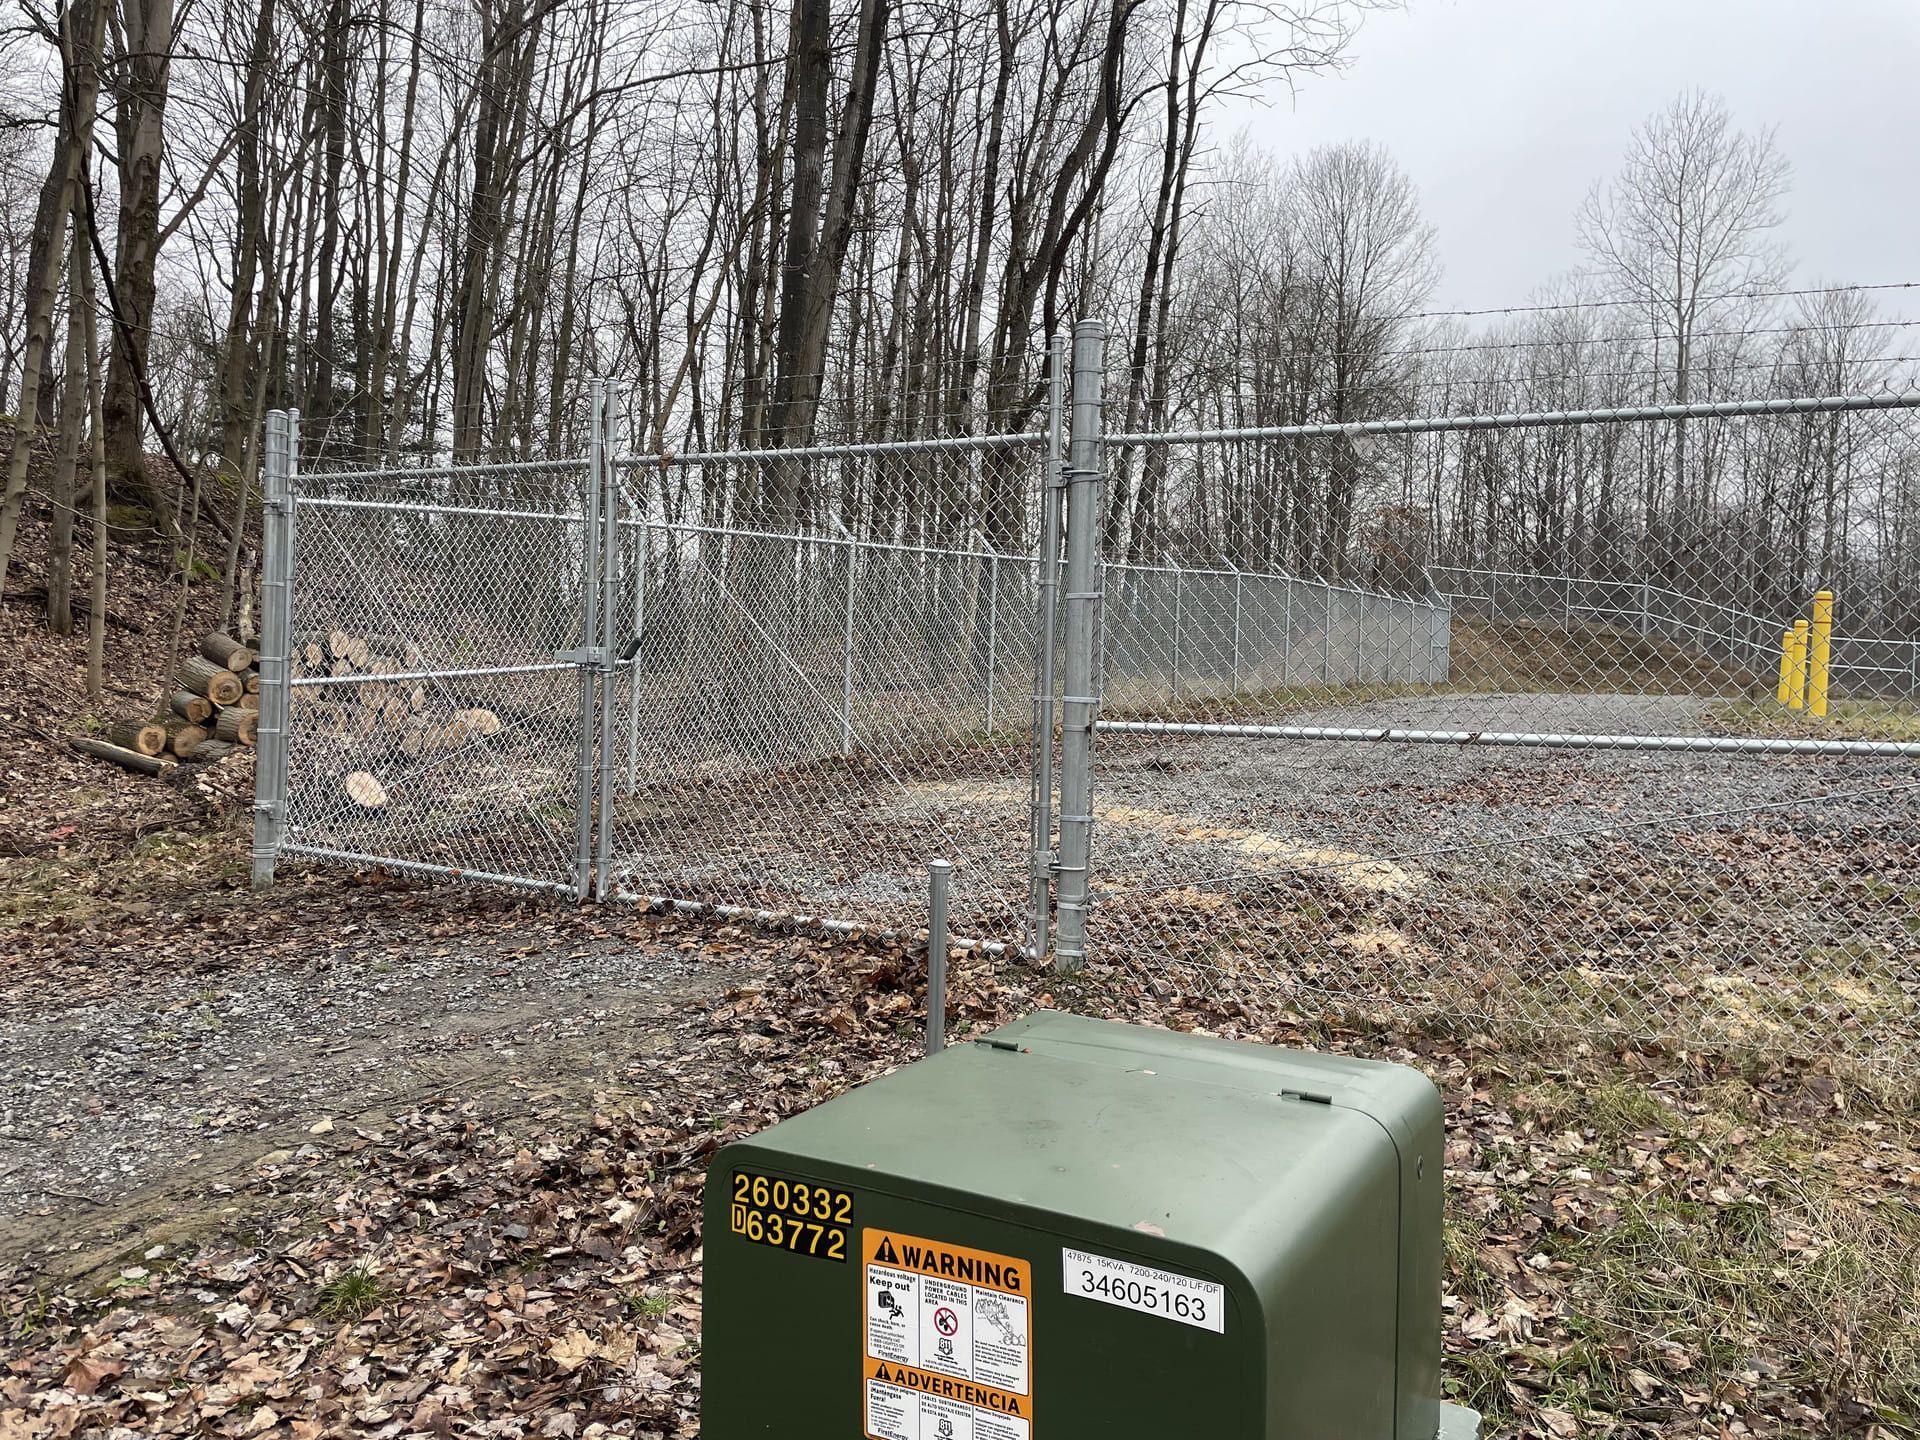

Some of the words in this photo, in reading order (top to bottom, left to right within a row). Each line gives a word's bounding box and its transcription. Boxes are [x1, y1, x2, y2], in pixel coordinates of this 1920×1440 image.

[734, 1174, 851, 1224] 260332
[902, 1244, 1020, 1291] WARNING
[1067, 1251, 1092, 1264] 47875
[1097, 1258, 1125, 1272] 15KVA
[1130, 1266, 1187, 1287] 7200-240/120
[1189, 1281, 1219, 1294] L/F/DF
[869, 1275, 893, 1290] Keep
[894, 1283, 910, 1292] out
[924, 1279, 967, 1293] UNDERGROUND
[924, 1285, 943, 1294] POWER
[946, 1290, 967, 1299] CABLES
[924, 1292, 947, 1301] LOCATED
[975, 1289, 997, 1298] Maintain
[1081, 1270, 1206, 1321] 34605163
[924, 1298, 938, 1306] AREA
[939, 1337, 952, 1350] 811
[878, 1349, 909, 1363] FirstEnergy
[895, 1369, 1020, 1415] ADVERTENCIA
[939, 1419, 952, 1431] 811
